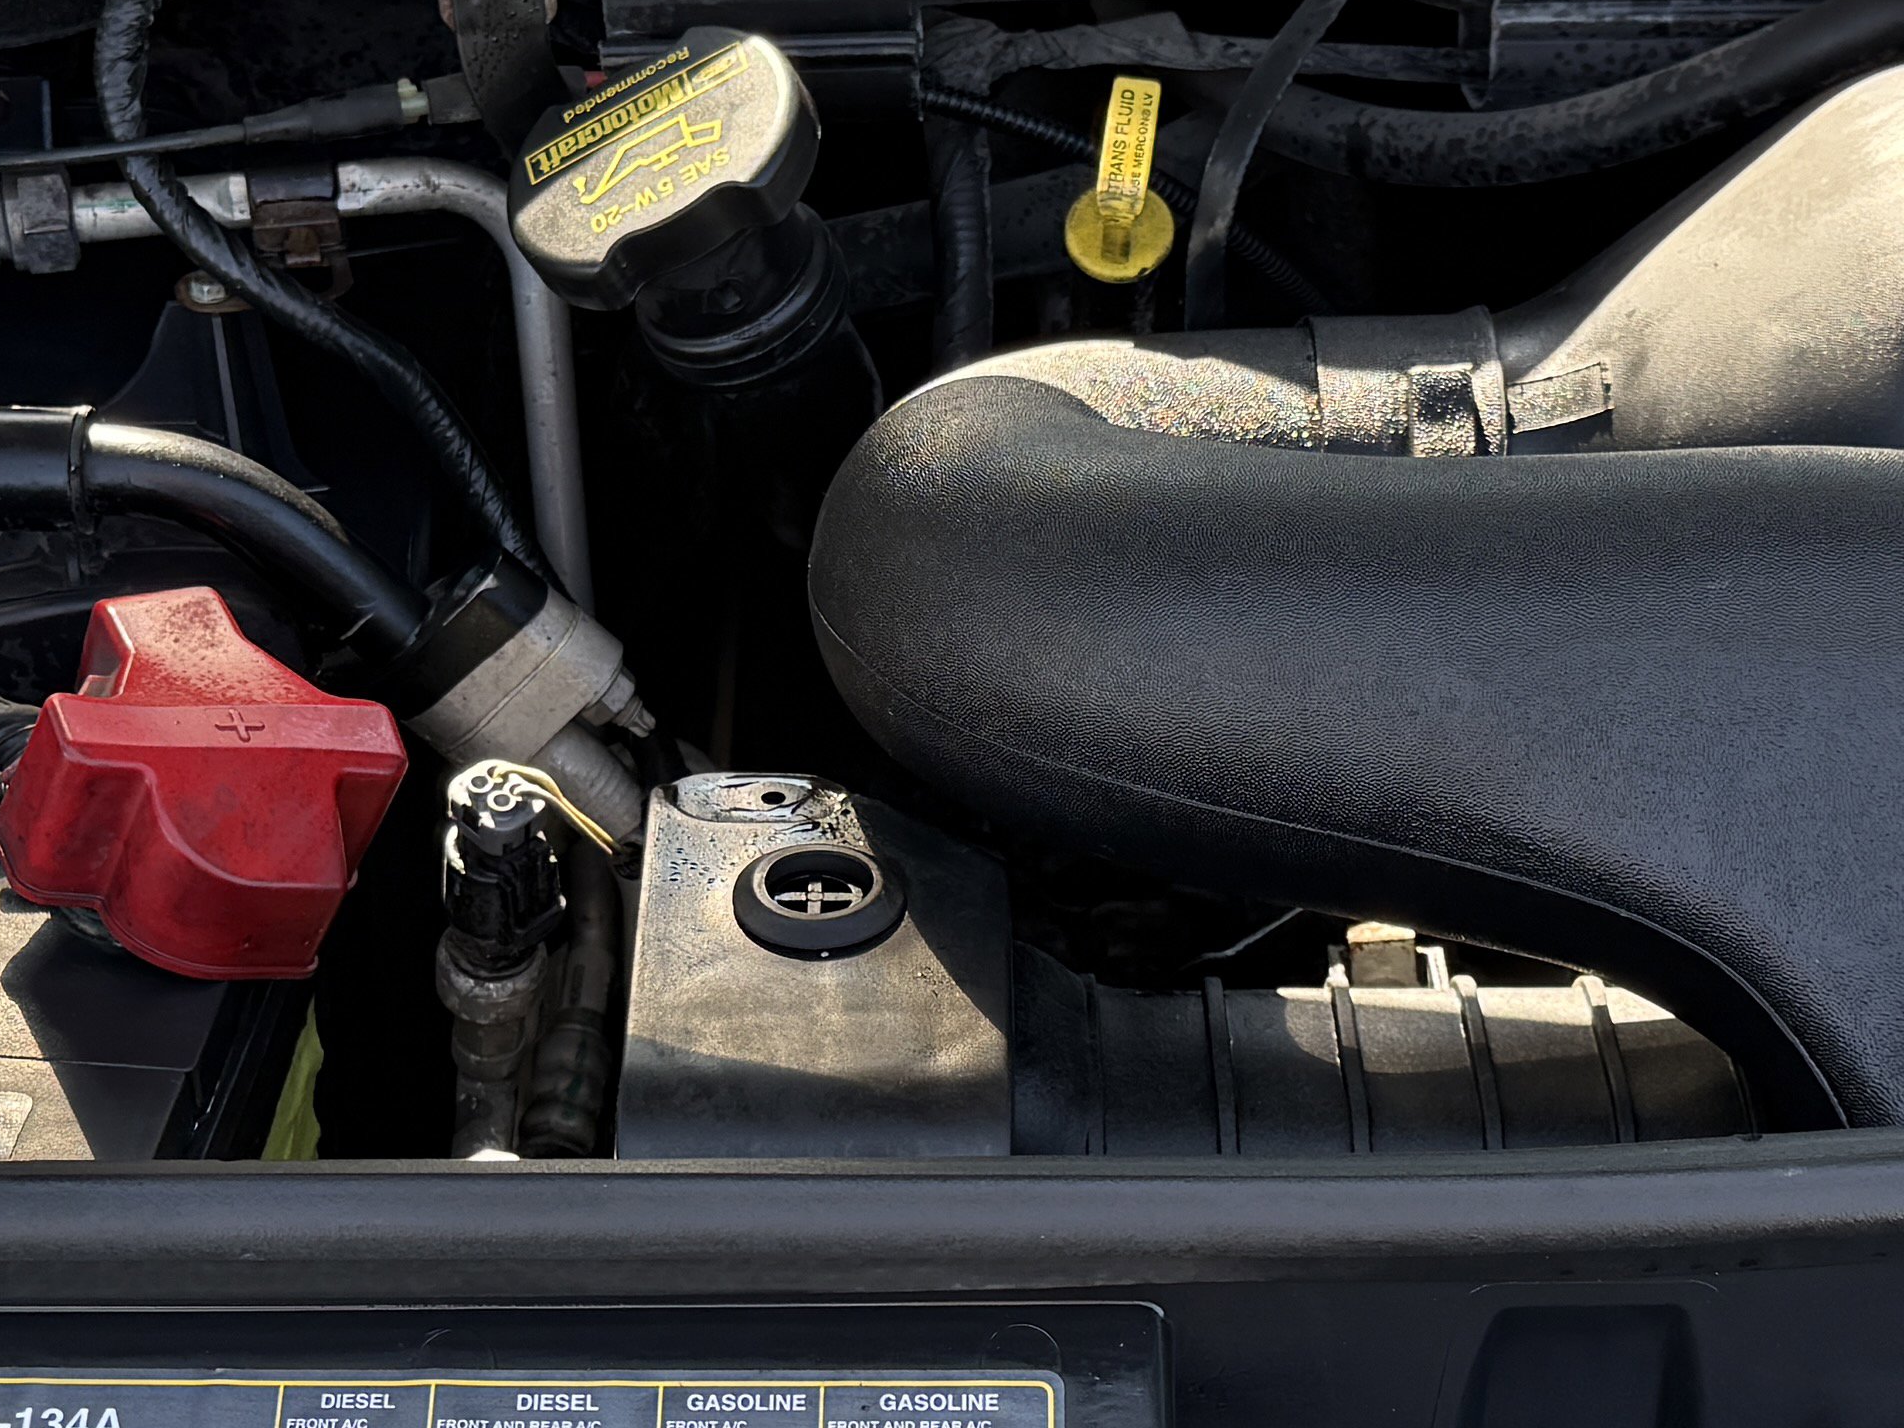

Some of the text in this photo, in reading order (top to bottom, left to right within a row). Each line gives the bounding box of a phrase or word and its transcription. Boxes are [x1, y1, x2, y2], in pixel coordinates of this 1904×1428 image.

[563, 47, 689, 123] Recommended
[532, 78, 687, 173] Motorcraft
[1108, 89, 1135, 192] TRANS FLUID
[679, 148, 730, 185] SAE
[320, 1392, 396, 1410] DIESEL
[515, 1393, 600, 1412] DIESEL
[686, 1393, 807, 1412] GASOLINE
[878, 1392, 999, 1412] GASOLINE
